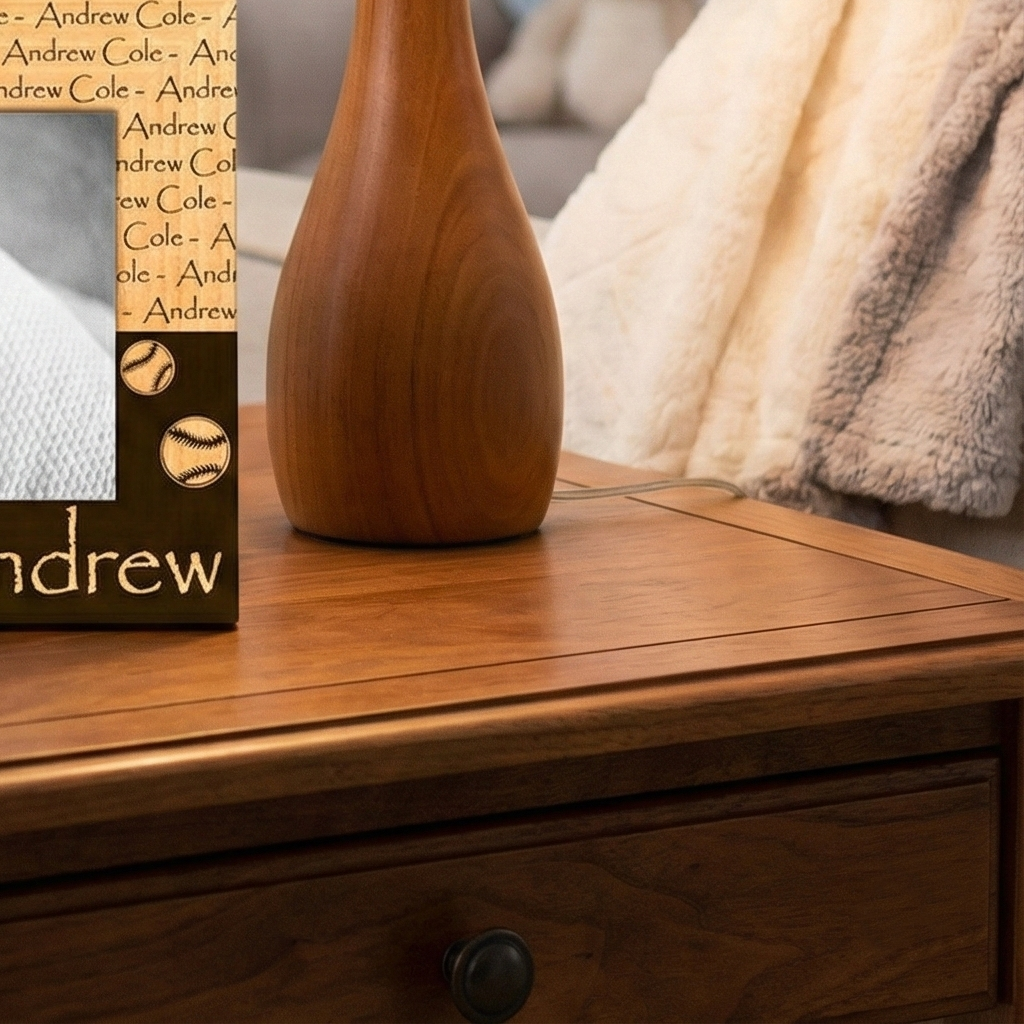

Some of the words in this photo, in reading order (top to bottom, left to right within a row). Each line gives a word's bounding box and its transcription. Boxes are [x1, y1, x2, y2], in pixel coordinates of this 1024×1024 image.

[35, 0, 130, 29] Andrew
[1, 37, 96, 66] Andrew
[155, 74, 236, 103] Andre
[122, 111, 216, 140] Andrew
[142, 295, 236, 324] Andrew
